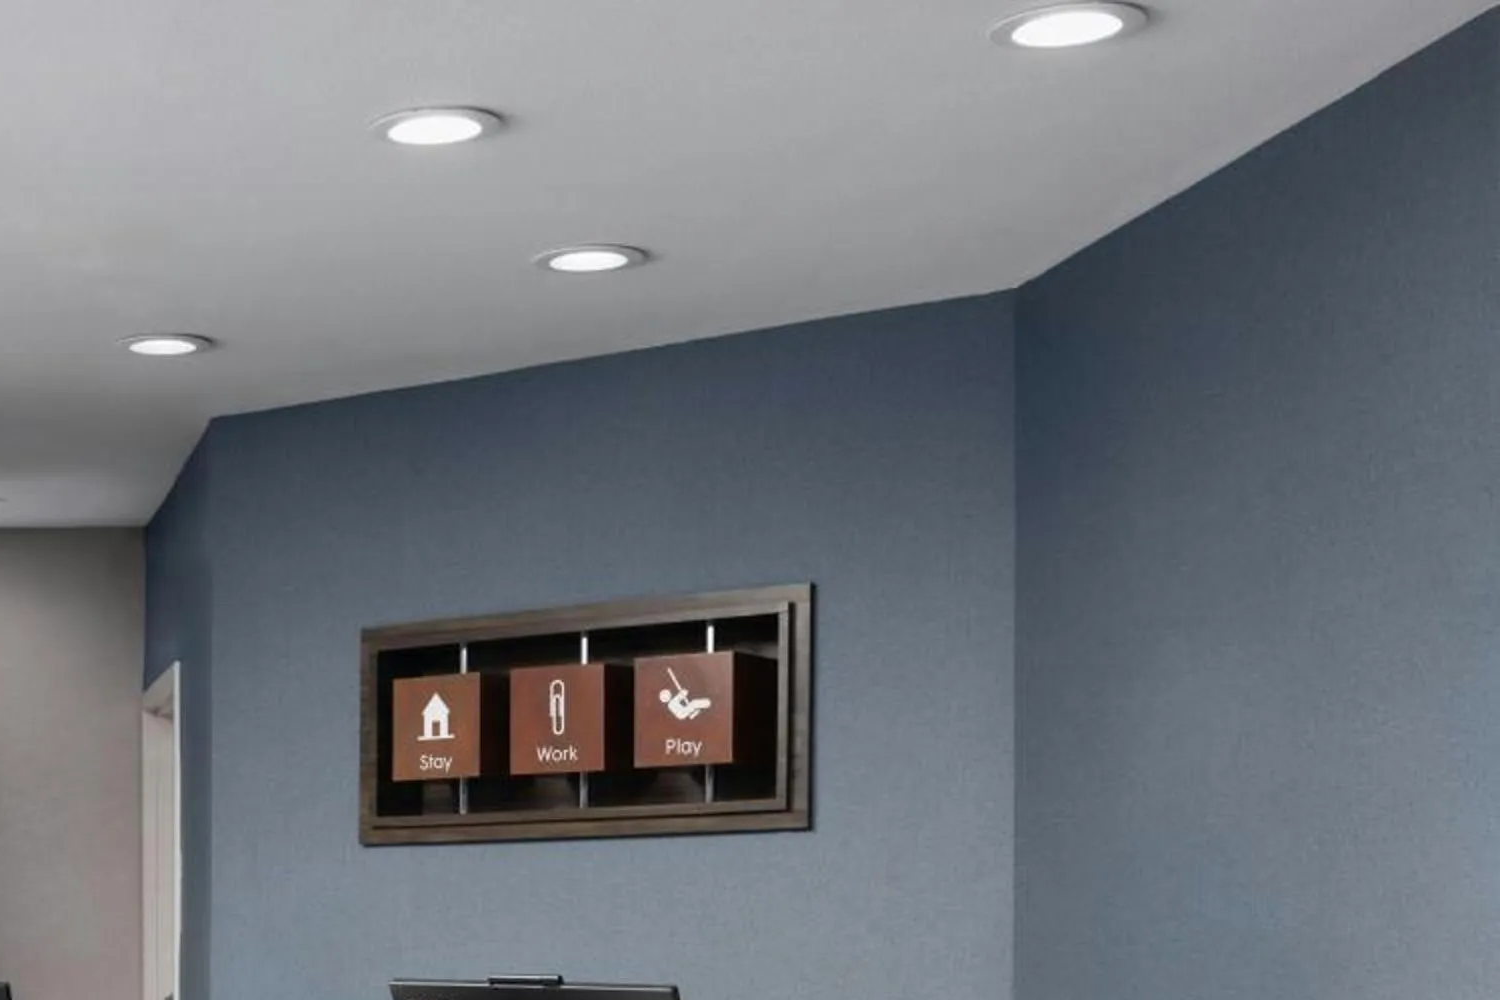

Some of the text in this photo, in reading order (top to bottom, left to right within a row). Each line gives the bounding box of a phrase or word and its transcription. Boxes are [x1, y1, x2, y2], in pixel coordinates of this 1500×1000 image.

[536, 745, 579, 763] Work
[665, 737, 703, 757] Play
[419, 754, 453, 772] Stay
